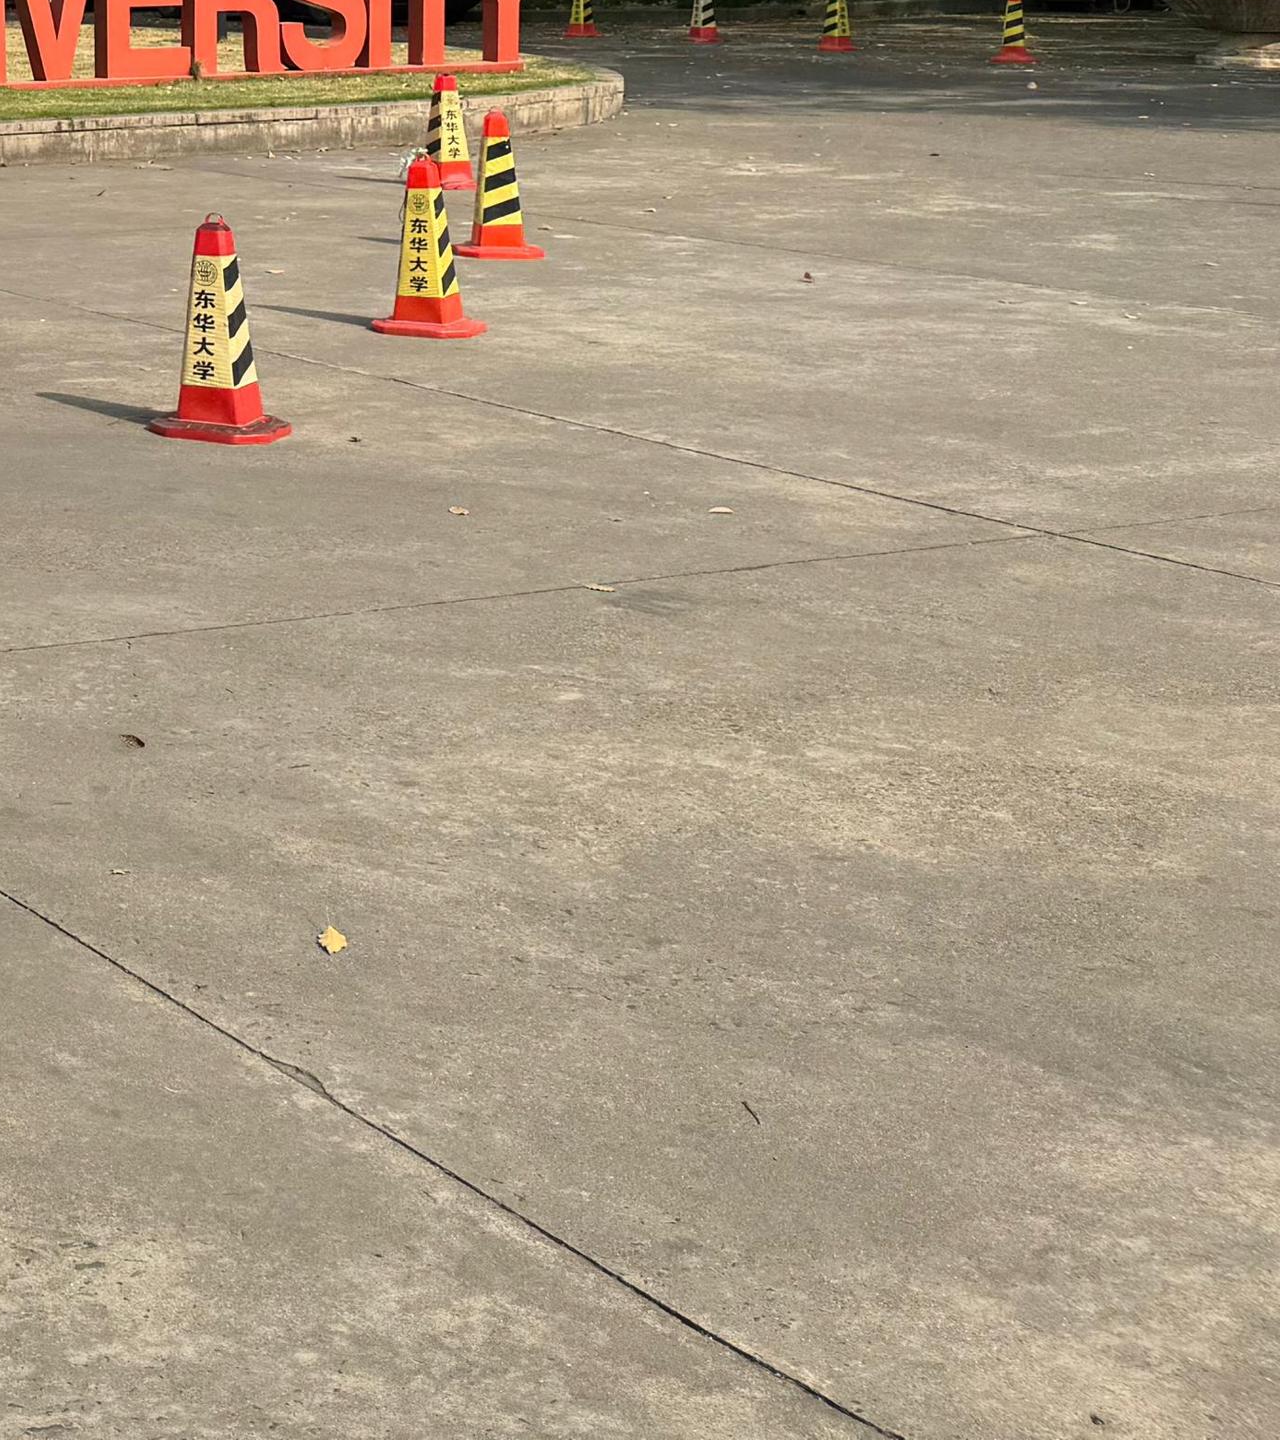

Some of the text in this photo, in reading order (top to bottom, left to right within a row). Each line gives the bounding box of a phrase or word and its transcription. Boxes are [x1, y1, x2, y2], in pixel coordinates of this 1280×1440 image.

[446, 110, 461, 158] 东华大学
[409, 218, 428, 293] 东华大学
[193, 290, 216, 380] 东华大学
